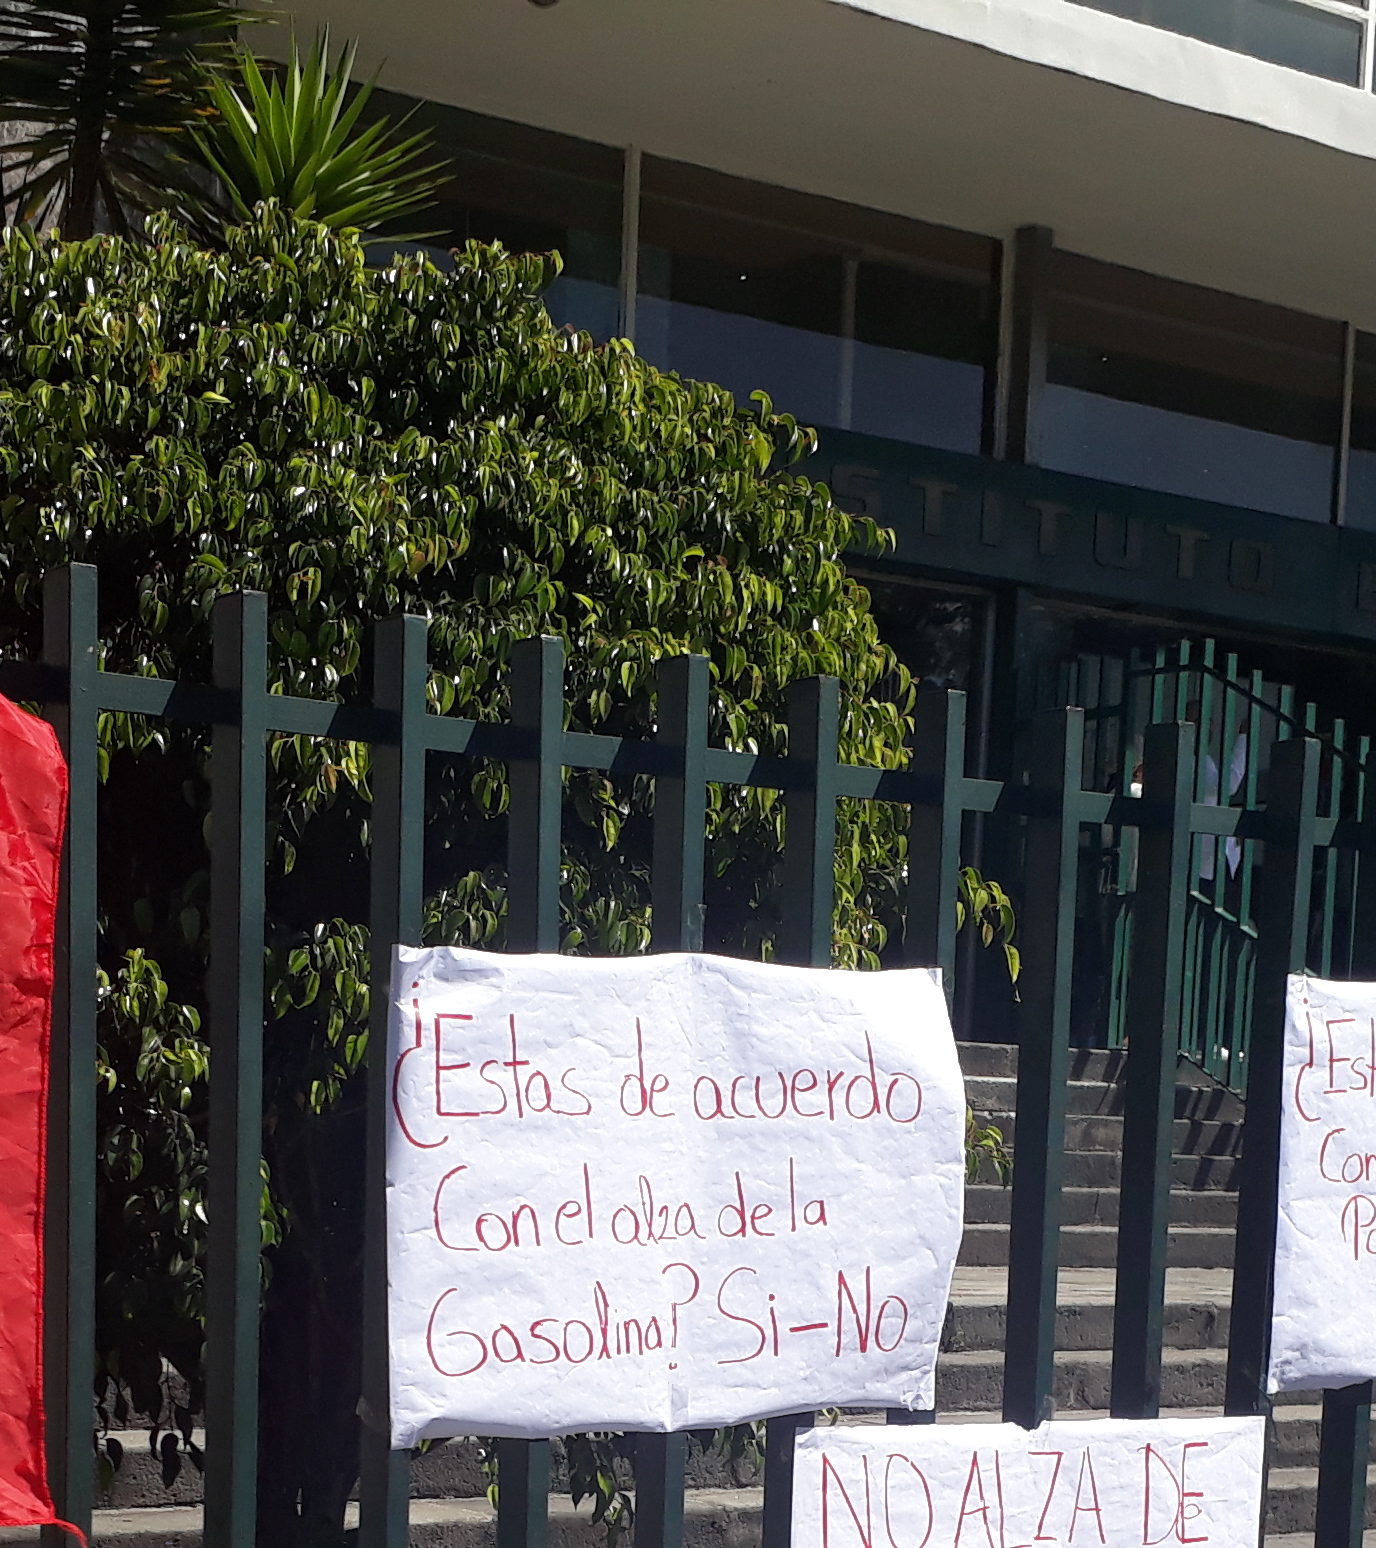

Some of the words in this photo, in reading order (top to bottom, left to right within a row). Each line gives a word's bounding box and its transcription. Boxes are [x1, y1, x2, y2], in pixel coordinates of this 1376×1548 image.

[831, 463, 1276, 592] STITUTO
[391, 982, 592, 1149] ¿Estas
[620, 1016, 676, 1118] de
[693, 1029, 923, 1123] acuerdo
[432, 1164, 542, 1252] Con
[554, 1161, 597, 1246] el
[611, 1174, 707, 1248] alza
[717, 1170, 776, 1239] de
[788, 1156, 828, 1234] la
[426, 1262, 700, 1378] Gasolina?
[1137, 1441, 1209, 1547] DE
